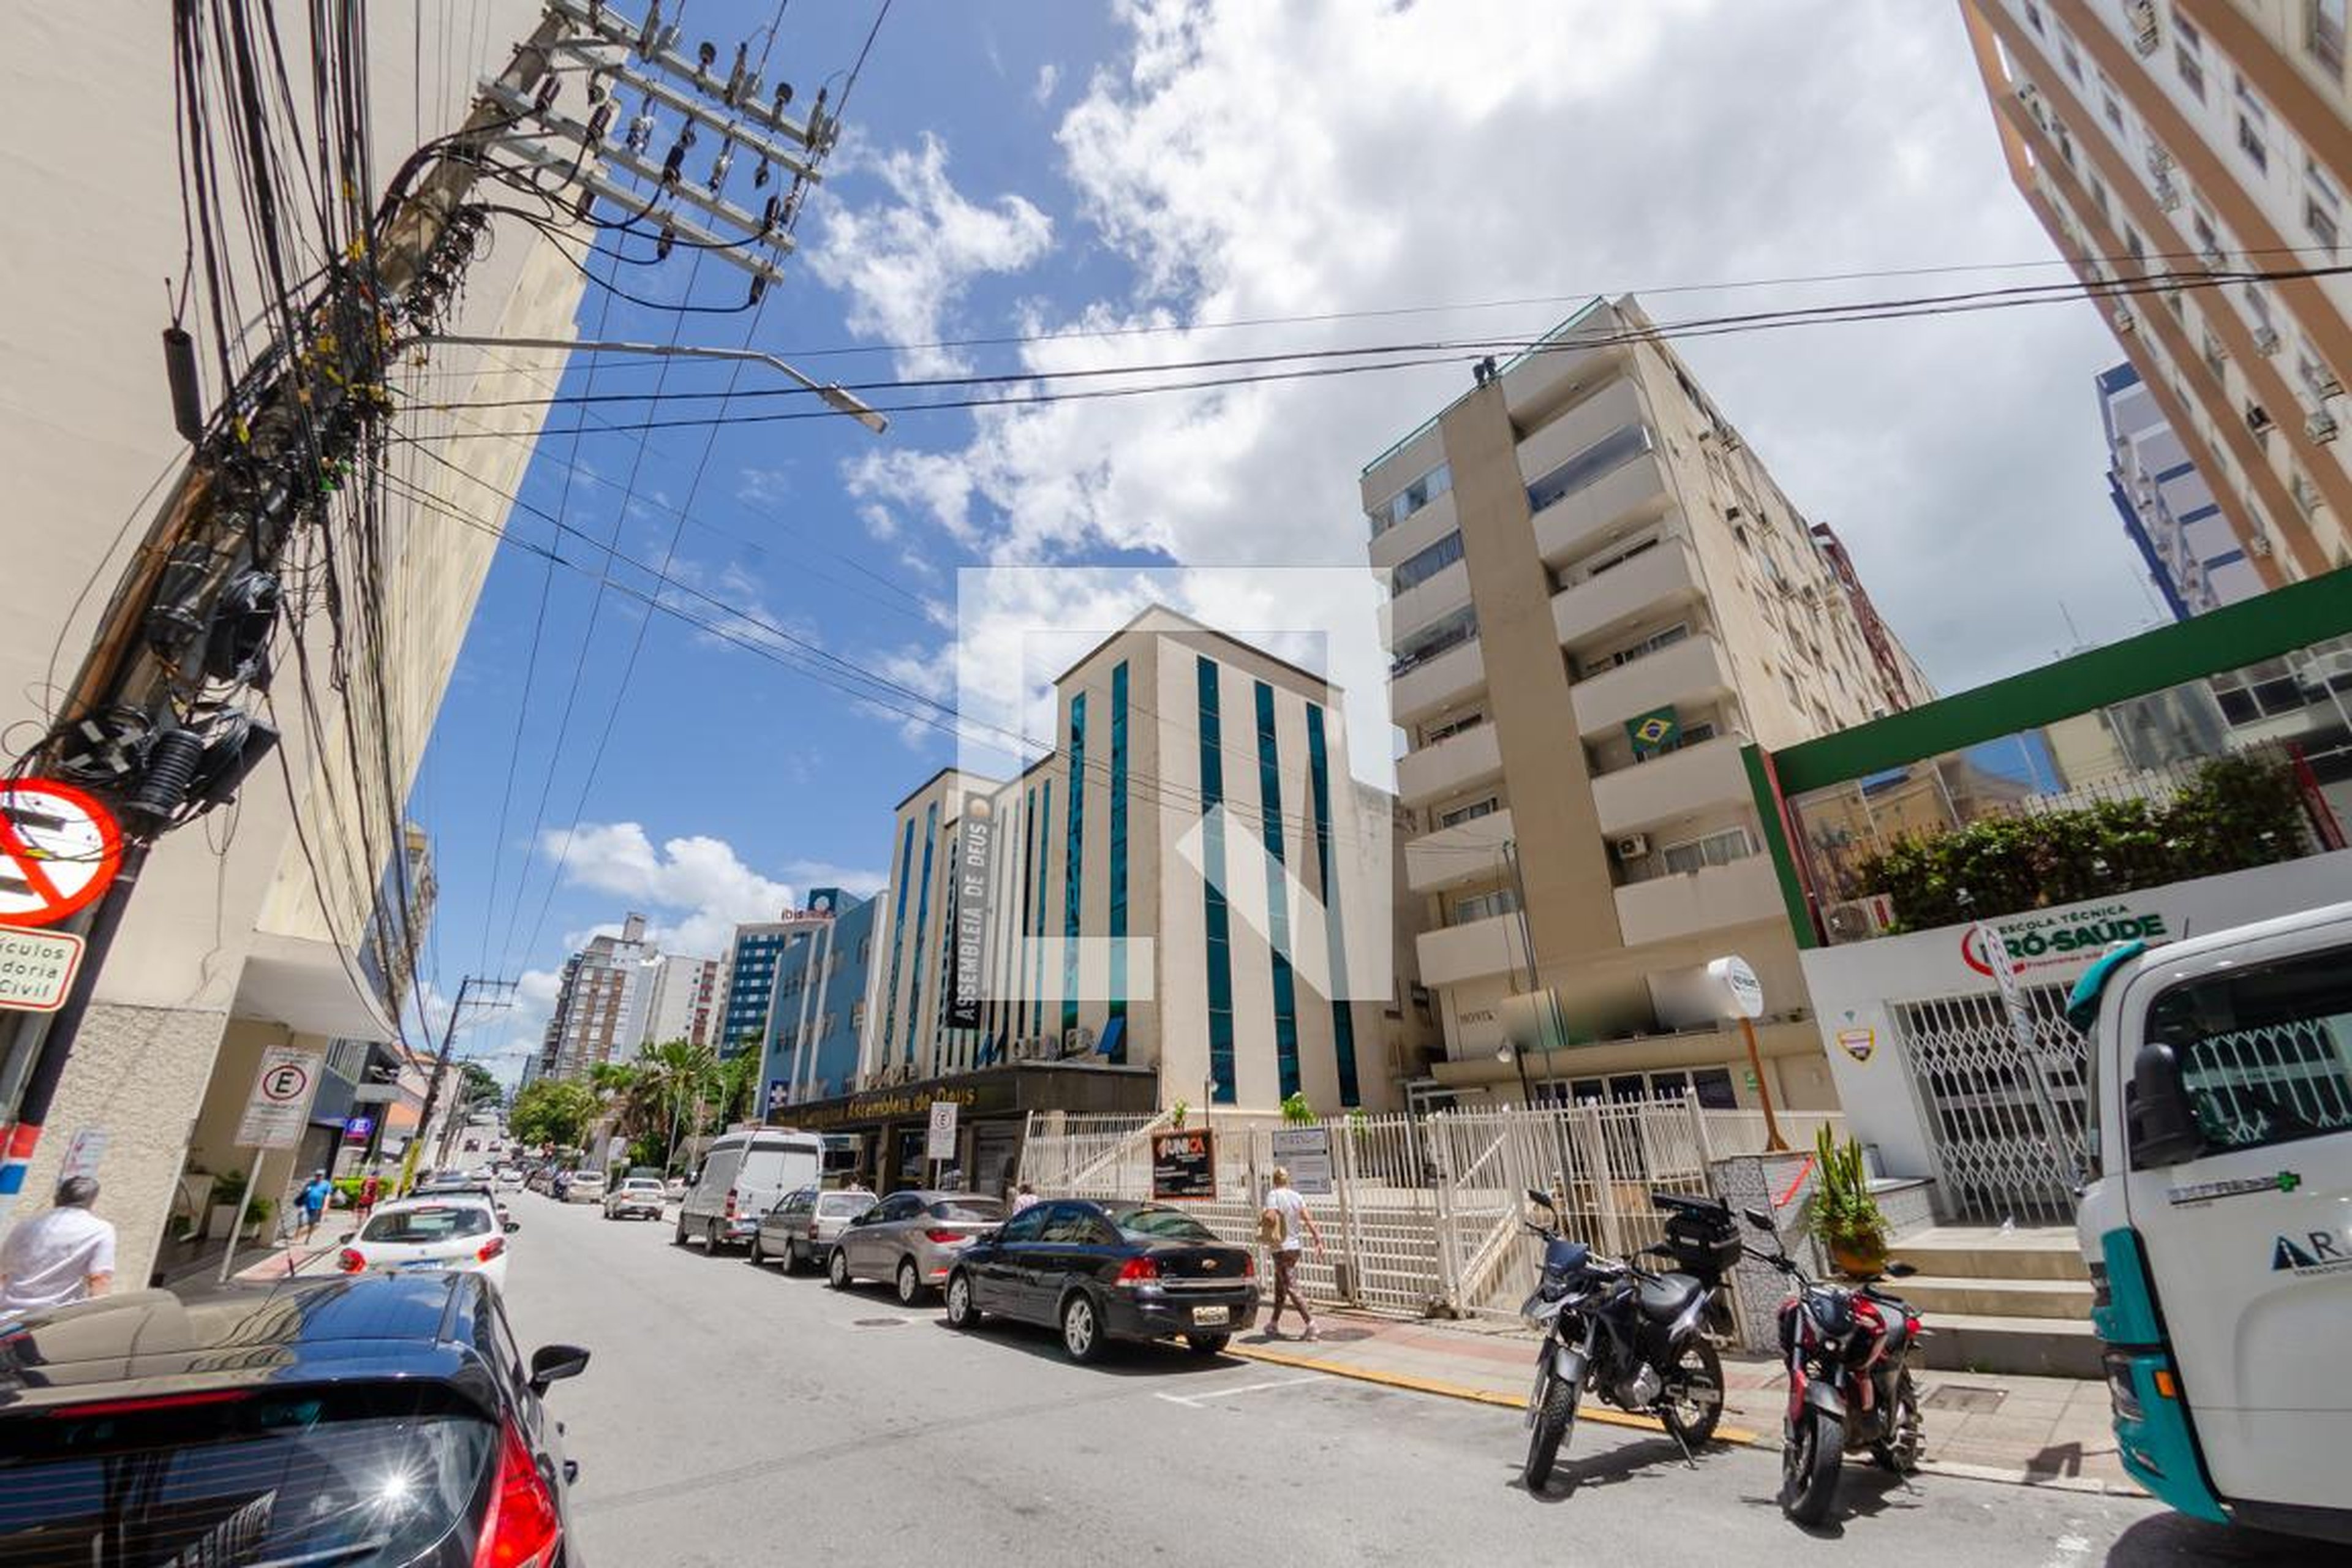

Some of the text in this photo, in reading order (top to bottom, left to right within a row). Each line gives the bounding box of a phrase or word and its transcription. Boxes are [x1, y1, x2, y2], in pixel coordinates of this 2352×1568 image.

[954, 822, 988, 1020] ASSEMBLEIA DE DEUS
[1999, 903, 2130, 935] ESCOLA TÉCNICA
[1979, 913, 2166, 964] RÓ-SAÚDE
[2, 961, 58, 979] doria
[275, 1072, 295, 1093] E
